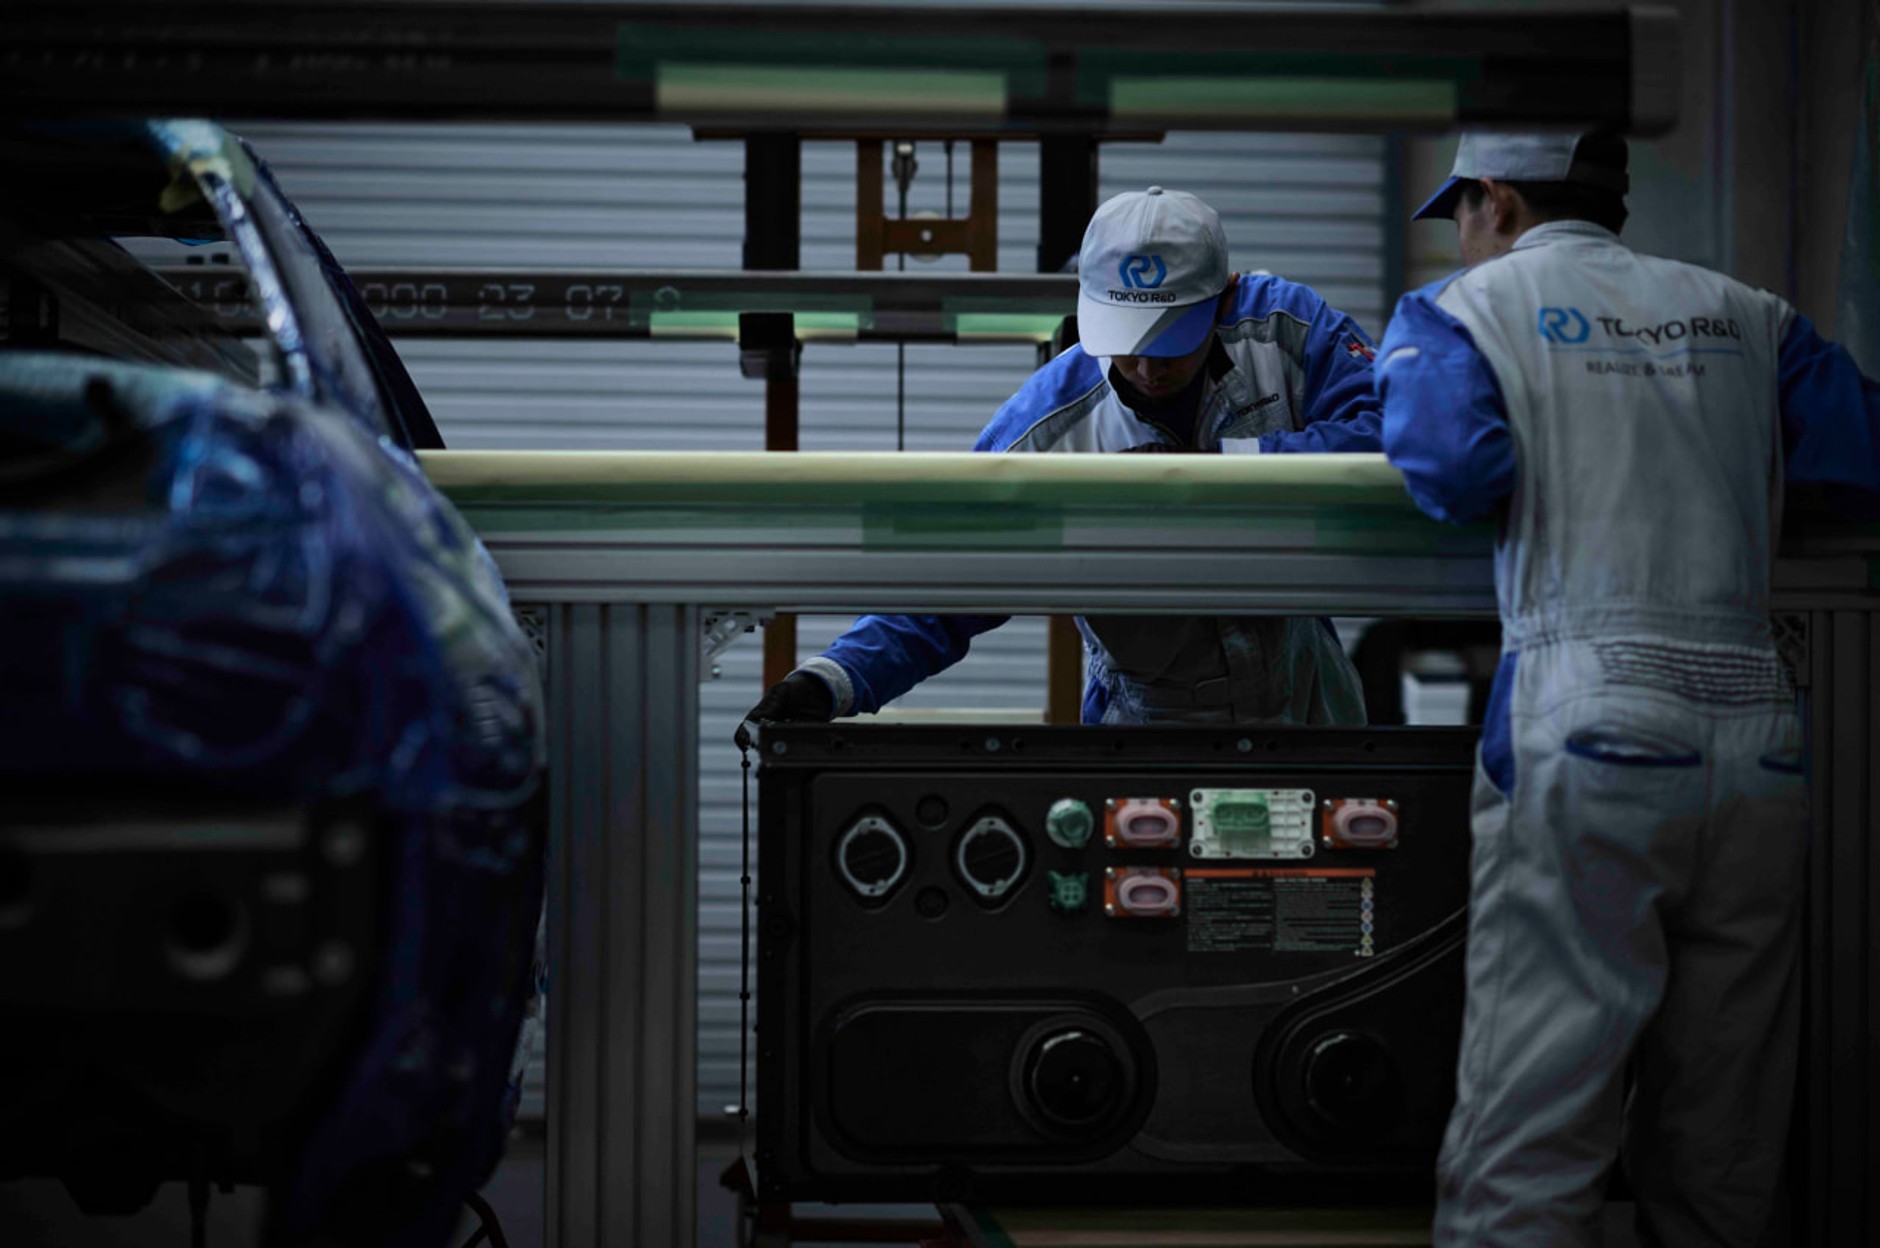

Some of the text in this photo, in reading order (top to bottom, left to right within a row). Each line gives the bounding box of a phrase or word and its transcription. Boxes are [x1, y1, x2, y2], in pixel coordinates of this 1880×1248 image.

[478, 283, 535, 320] 23
[565, 283, 623, 320] 07
[1108, 290, 1176, 303] TOKYO R&D
[1690, 317, 1740, 341] R&D
